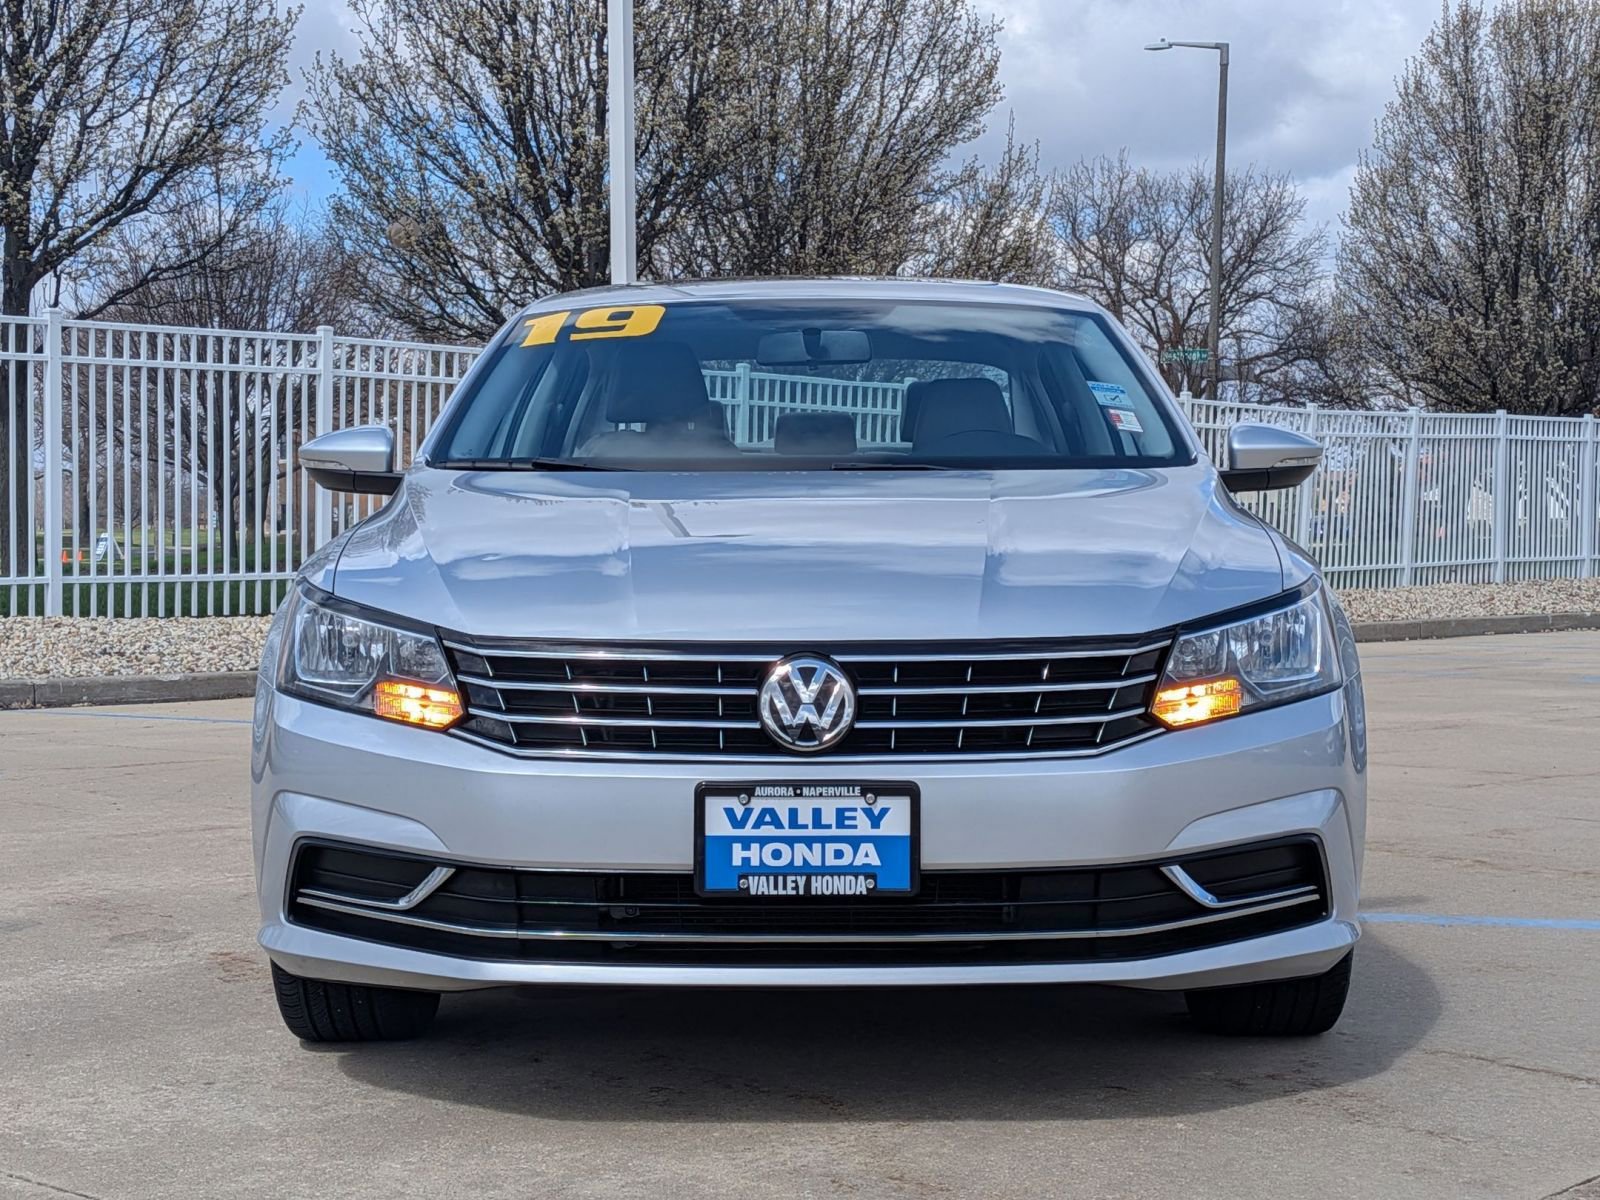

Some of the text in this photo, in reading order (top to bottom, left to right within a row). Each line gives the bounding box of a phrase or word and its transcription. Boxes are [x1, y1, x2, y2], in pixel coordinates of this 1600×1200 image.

[519, 305, 666, 348] 19
[762, 658, 852, 747] VW
[754, 786, 861, 797] AURORA NAPERVILLE
[722, 807, 891, 830] VALLEY
[731, 842, 882, 867] HONDA
[747, 875, 868, 896] VALLEY HONDA
